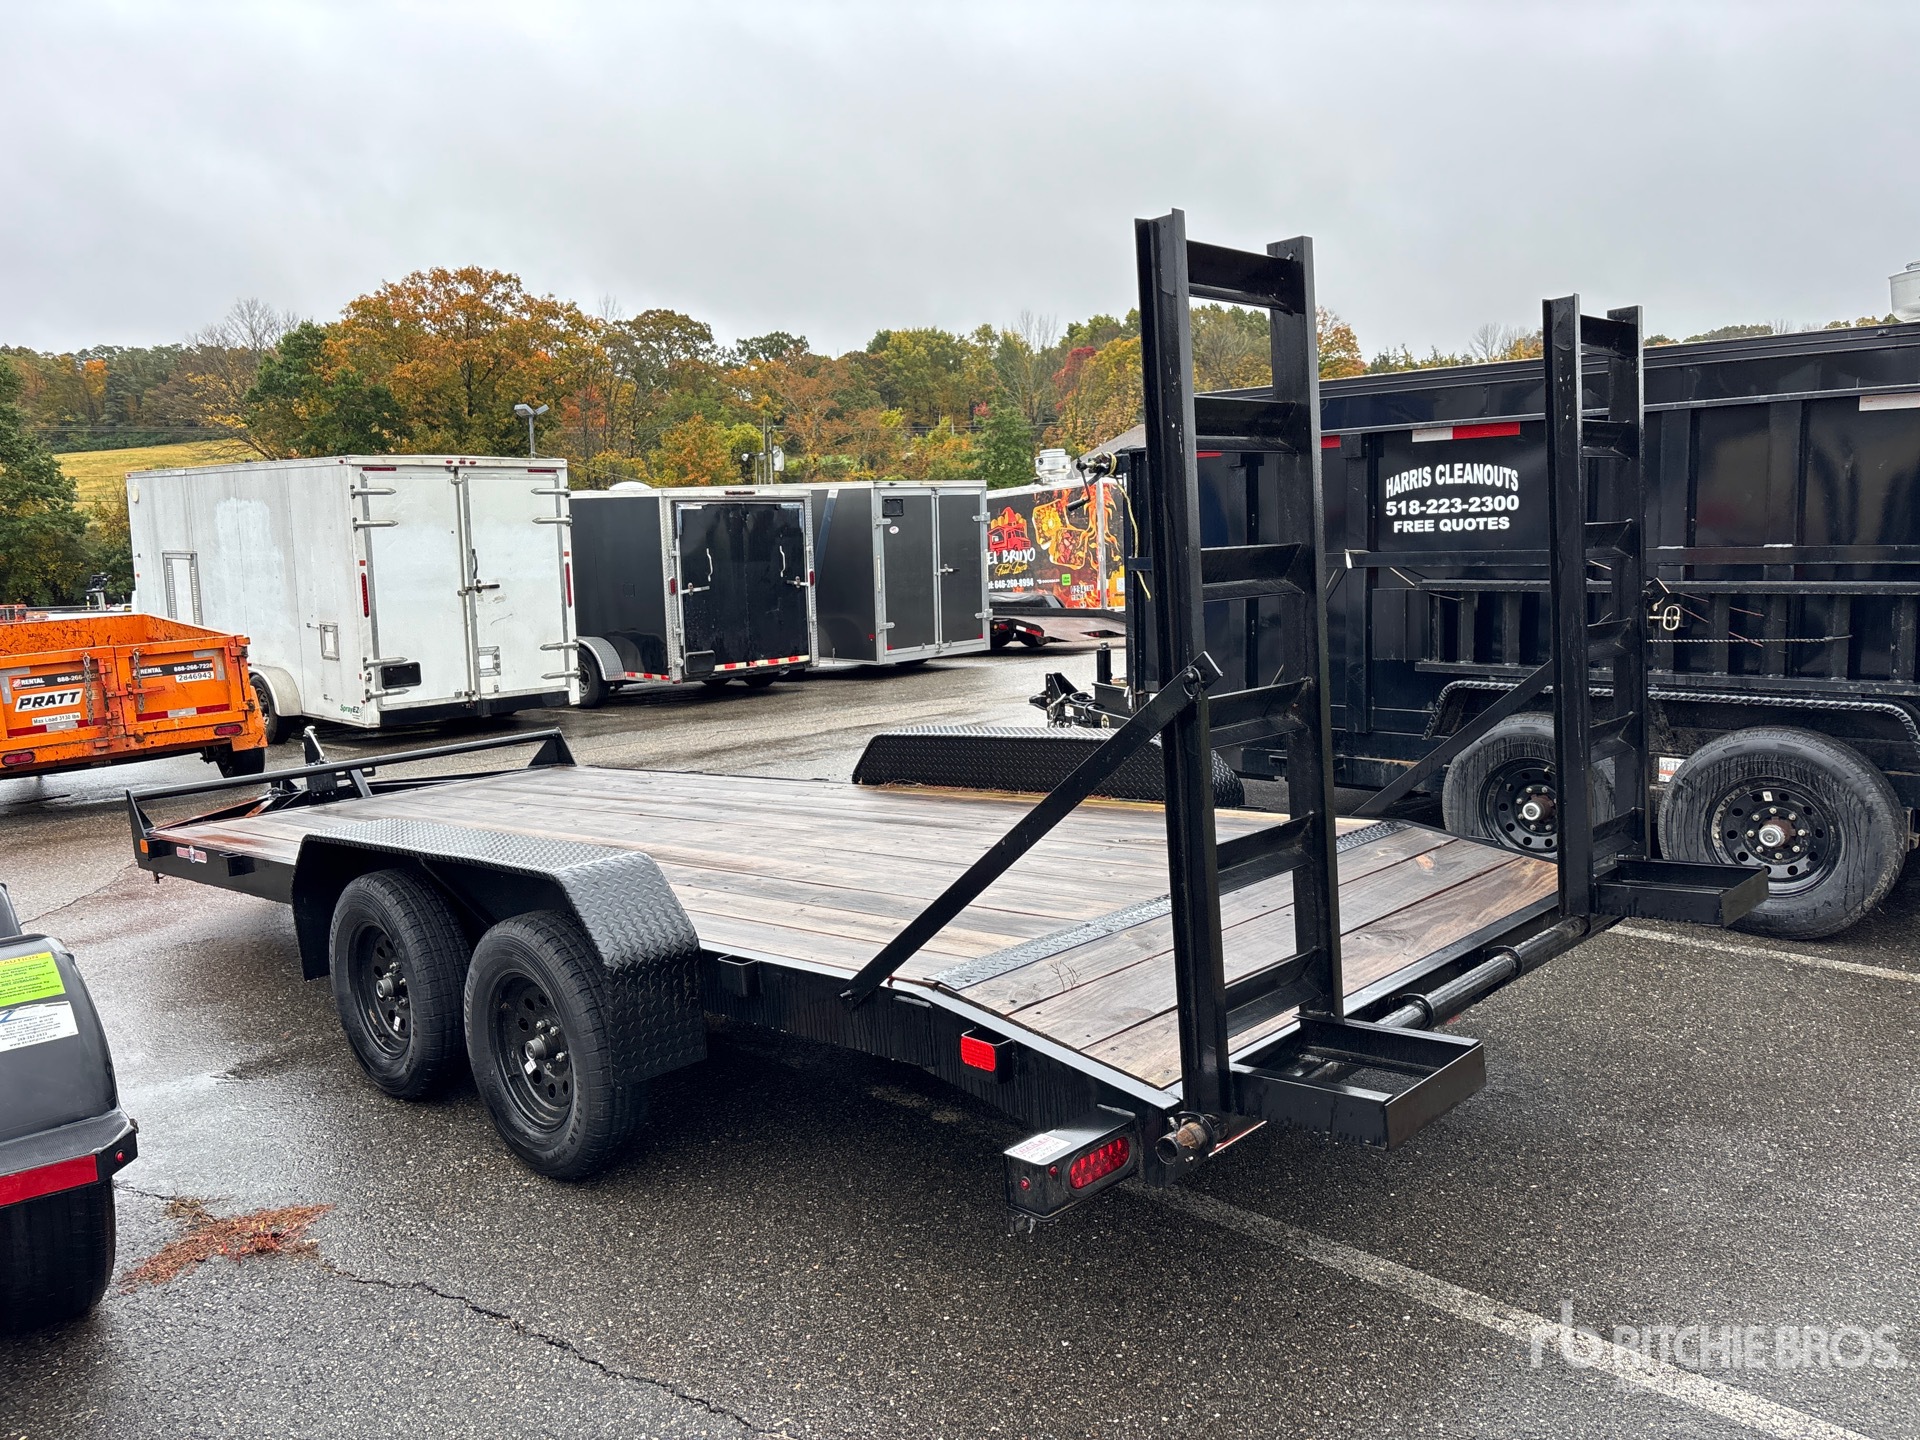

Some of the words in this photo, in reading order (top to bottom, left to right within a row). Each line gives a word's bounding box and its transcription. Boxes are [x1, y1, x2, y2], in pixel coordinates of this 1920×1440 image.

[1385, 466, 1432, 498] HARRIS
[1435, 463, 1519, 491] CLEANOUTS
[1385, 495, 1520, 516] 518-223-2300
[1393, 519, 1435, 533] FREE
[1439, 516, 1510, 532] QUOTES
[140, 667, 163, 675] RENTAL
[178, 671, 213, 682] 2846943
[20, 677, 45, 686] RENTAL
[18, 691, 81, 711] PRATT
[340, 704, 360, 714] SprayEZ
[33, 717, 44, 725] Max
[45, 716, 58, 724] Load
